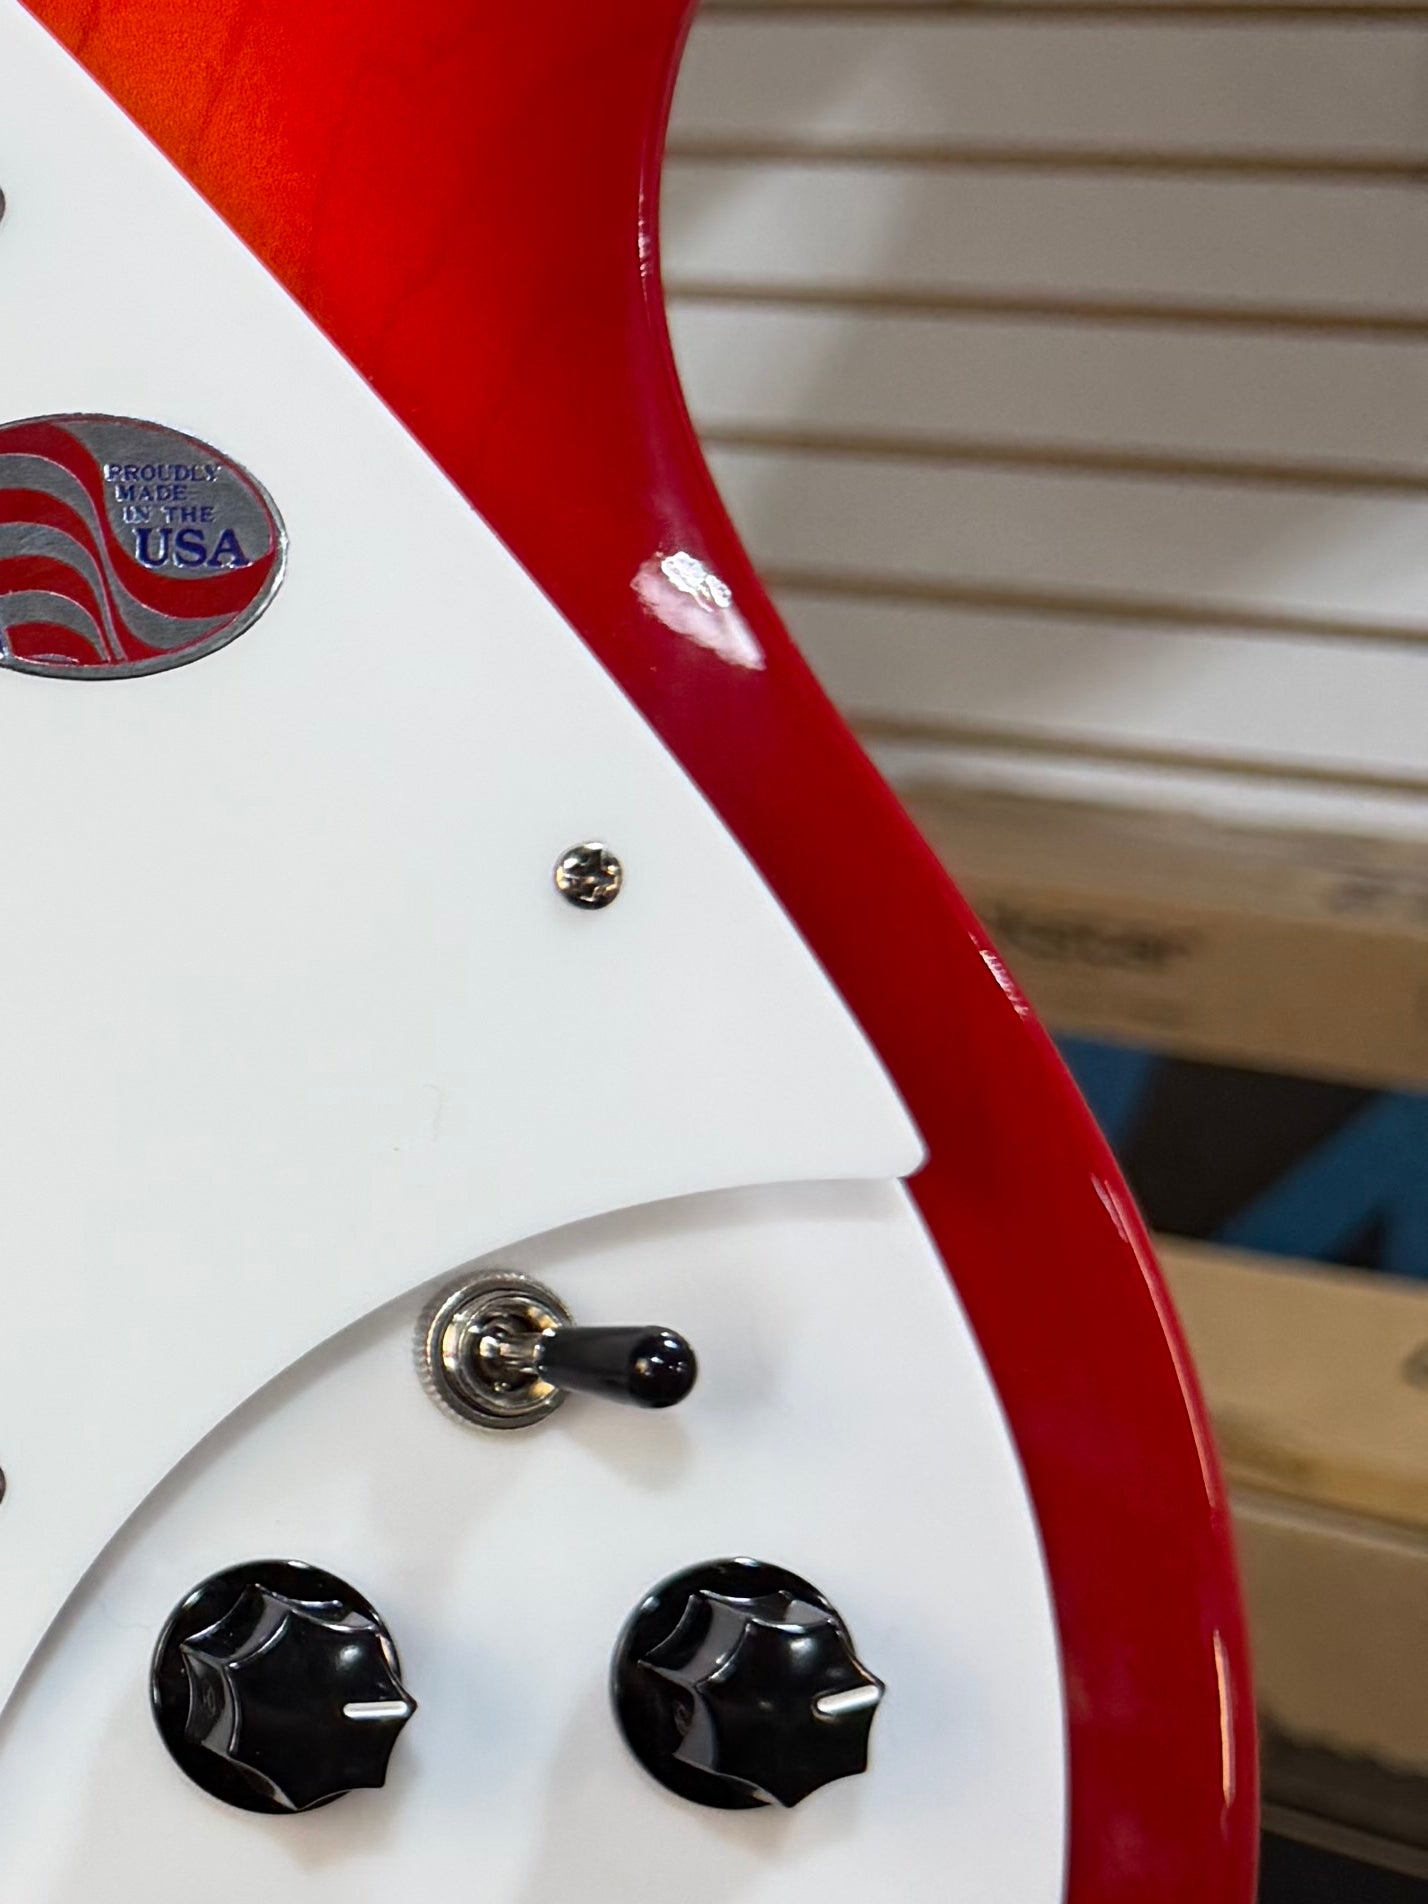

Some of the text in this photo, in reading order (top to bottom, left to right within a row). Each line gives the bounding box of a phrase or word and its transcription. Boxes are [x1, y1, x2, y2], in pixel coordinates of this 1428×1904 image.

[104, 463, 221, 482] PROUDLY
[115, 484, 188, 502] MADE
[123, 506, 215, 523] IN THE
[134, 527, 254, 569] USA
